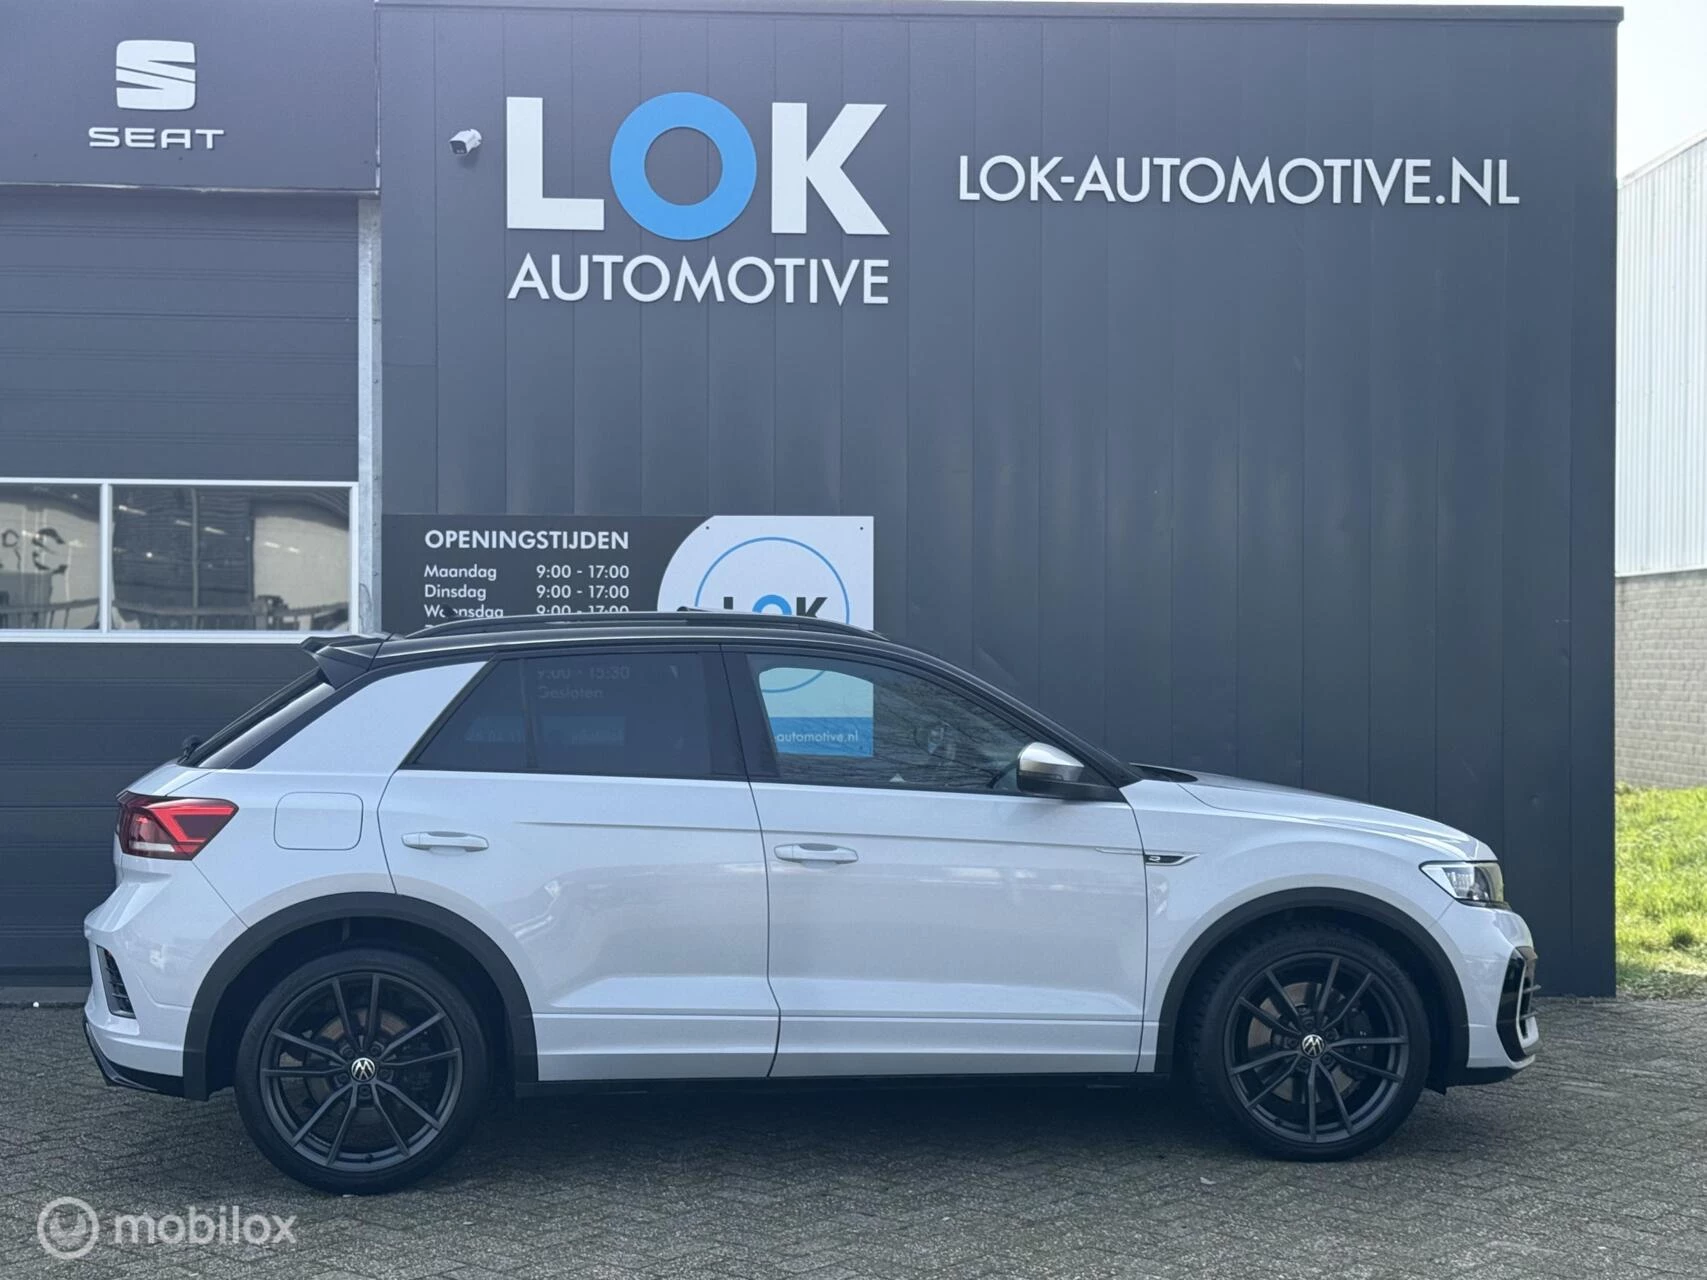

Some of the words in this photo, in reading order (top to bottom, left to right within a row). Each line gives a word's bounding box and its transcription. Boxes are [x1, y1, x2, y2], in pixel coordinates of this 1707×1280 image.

[88, 127, 225, 150] SEAT
[506, 92, 890, 240] LOK
[958, 154, 1520, 206] LOK-AUTOMOTIVE.NL
[508, 253, 890, 305] AUTOMOTIVE
[424, 529, 629, 550] OPENINGSTIJDEN
[423, 564, 497, 581] Maandag
[536, 564, 571, 579] 9:00
[588, 565, 630, 579] 17:00
[424, 584, 487, 601] Dinsdag
[536, 584, 571, 599] 9:00
[588, 585, 630, 599] 17:00
